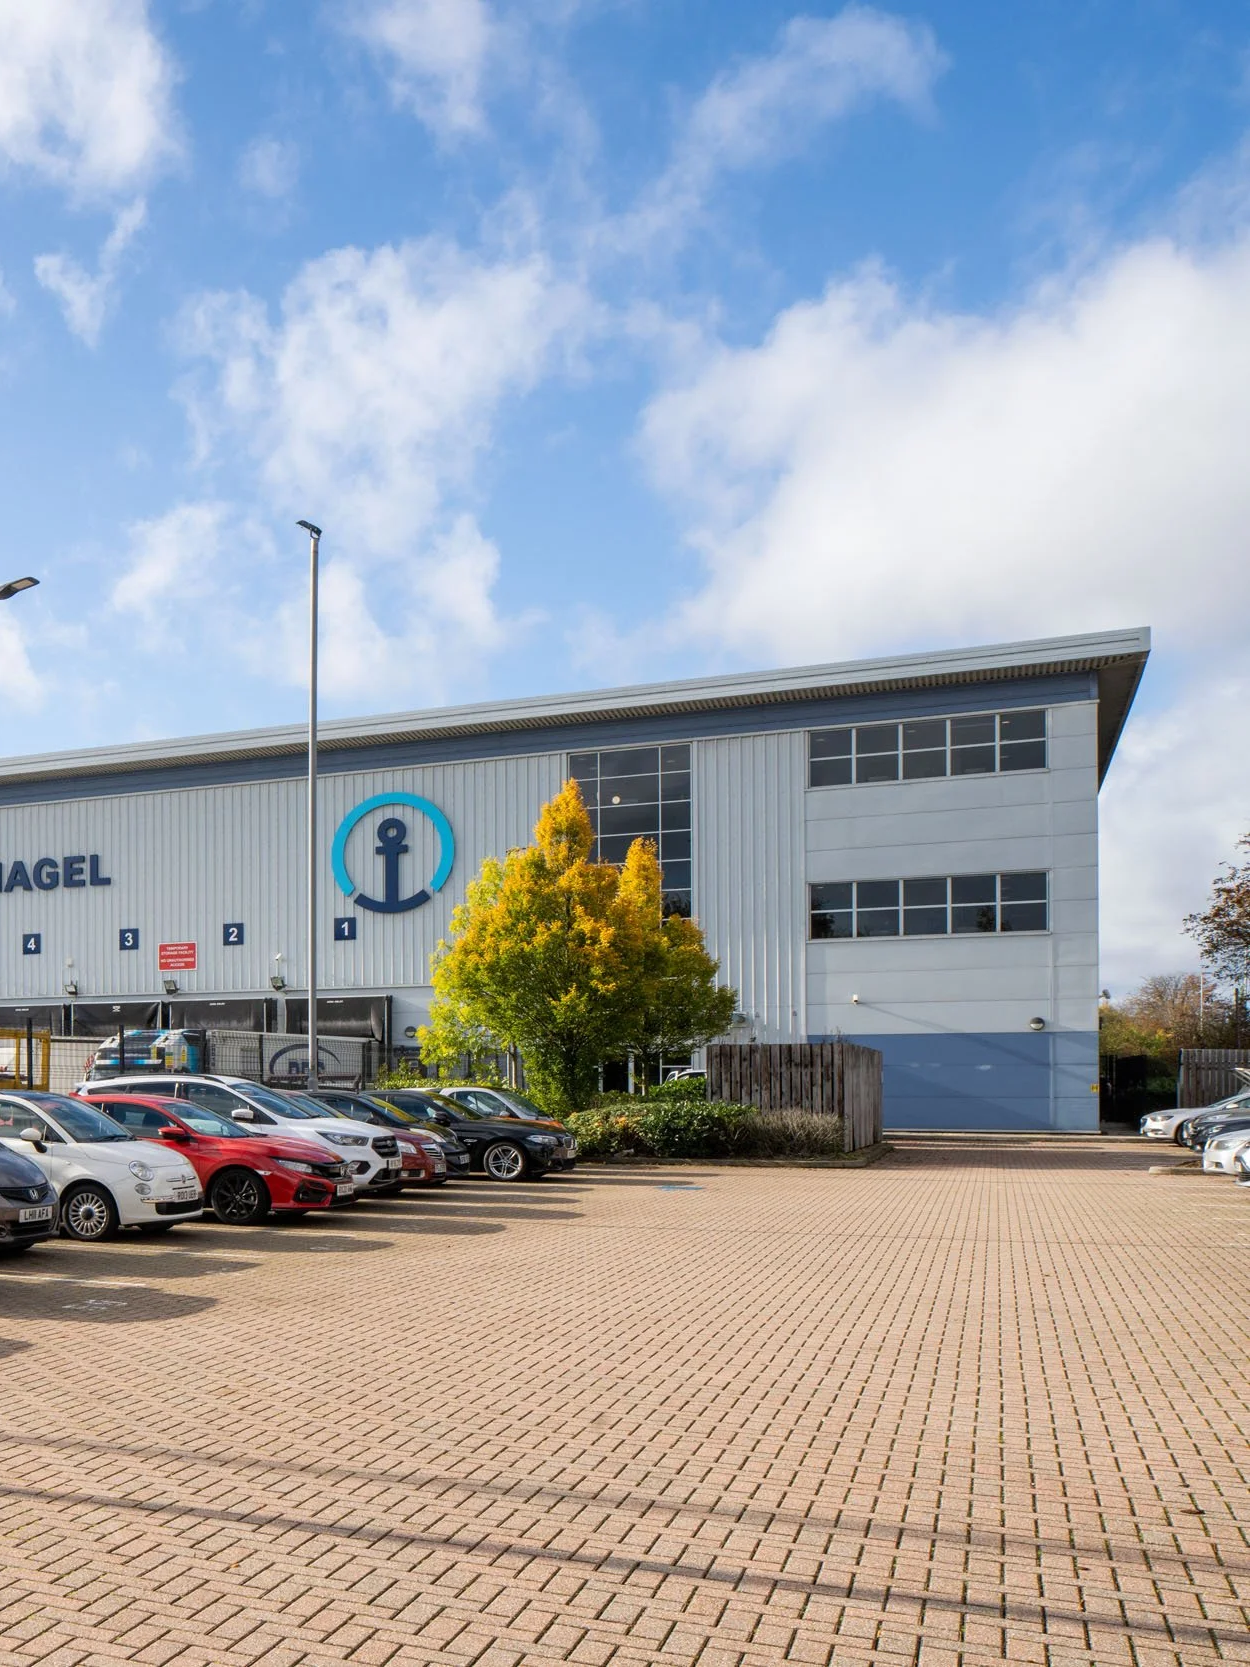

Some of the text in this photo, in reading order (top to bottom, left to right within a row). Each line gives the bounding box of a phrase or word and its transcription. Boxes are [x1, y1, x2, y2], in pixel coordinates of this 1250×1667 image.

[228, 927, 238, 941] 2
[342, 922, 349, 936] 1
[26, 937, 36, 950] 4
[124, 932, 134, 946] 3
[38, 1208, 49, 1218] AFA
